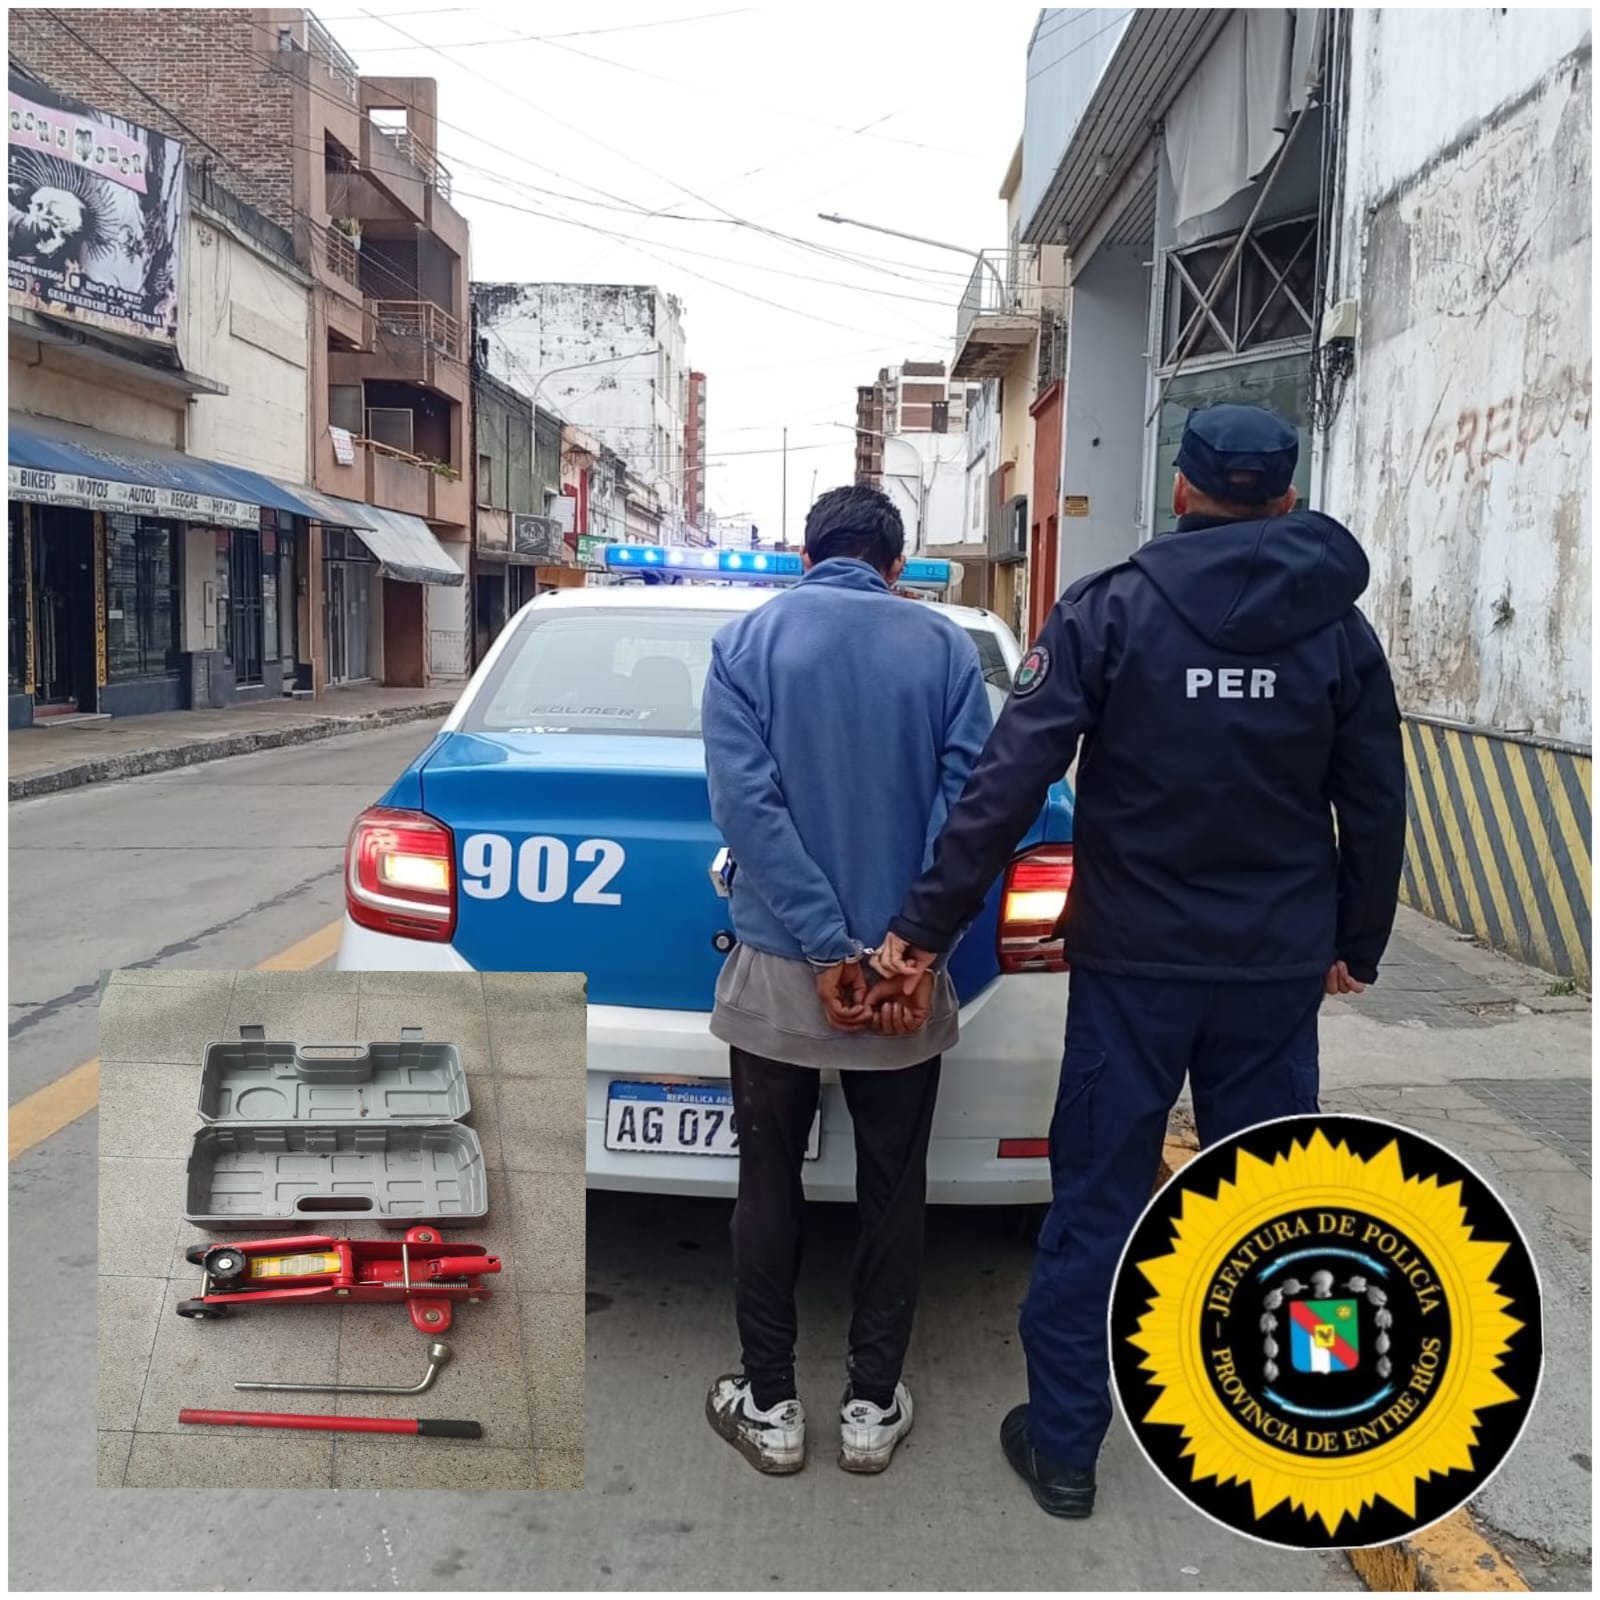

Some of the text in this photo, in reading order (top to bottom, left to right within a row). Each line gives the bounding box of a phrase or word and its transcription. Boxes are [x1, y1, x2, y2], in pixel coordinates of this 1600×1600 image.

[20, 470, 57, 490] BIKERS
[76, 478, 109, 498] MOTOS
[128, 487, 156, 504] AUTOS
[171, 492, 198, 509] REGGAE
[1186, 668, 1277, 699] PER
[462, 833, 626, 906] 902
[716, 1096, 733, 1105] ARG
[617, 1105, 663, 1144] AG
